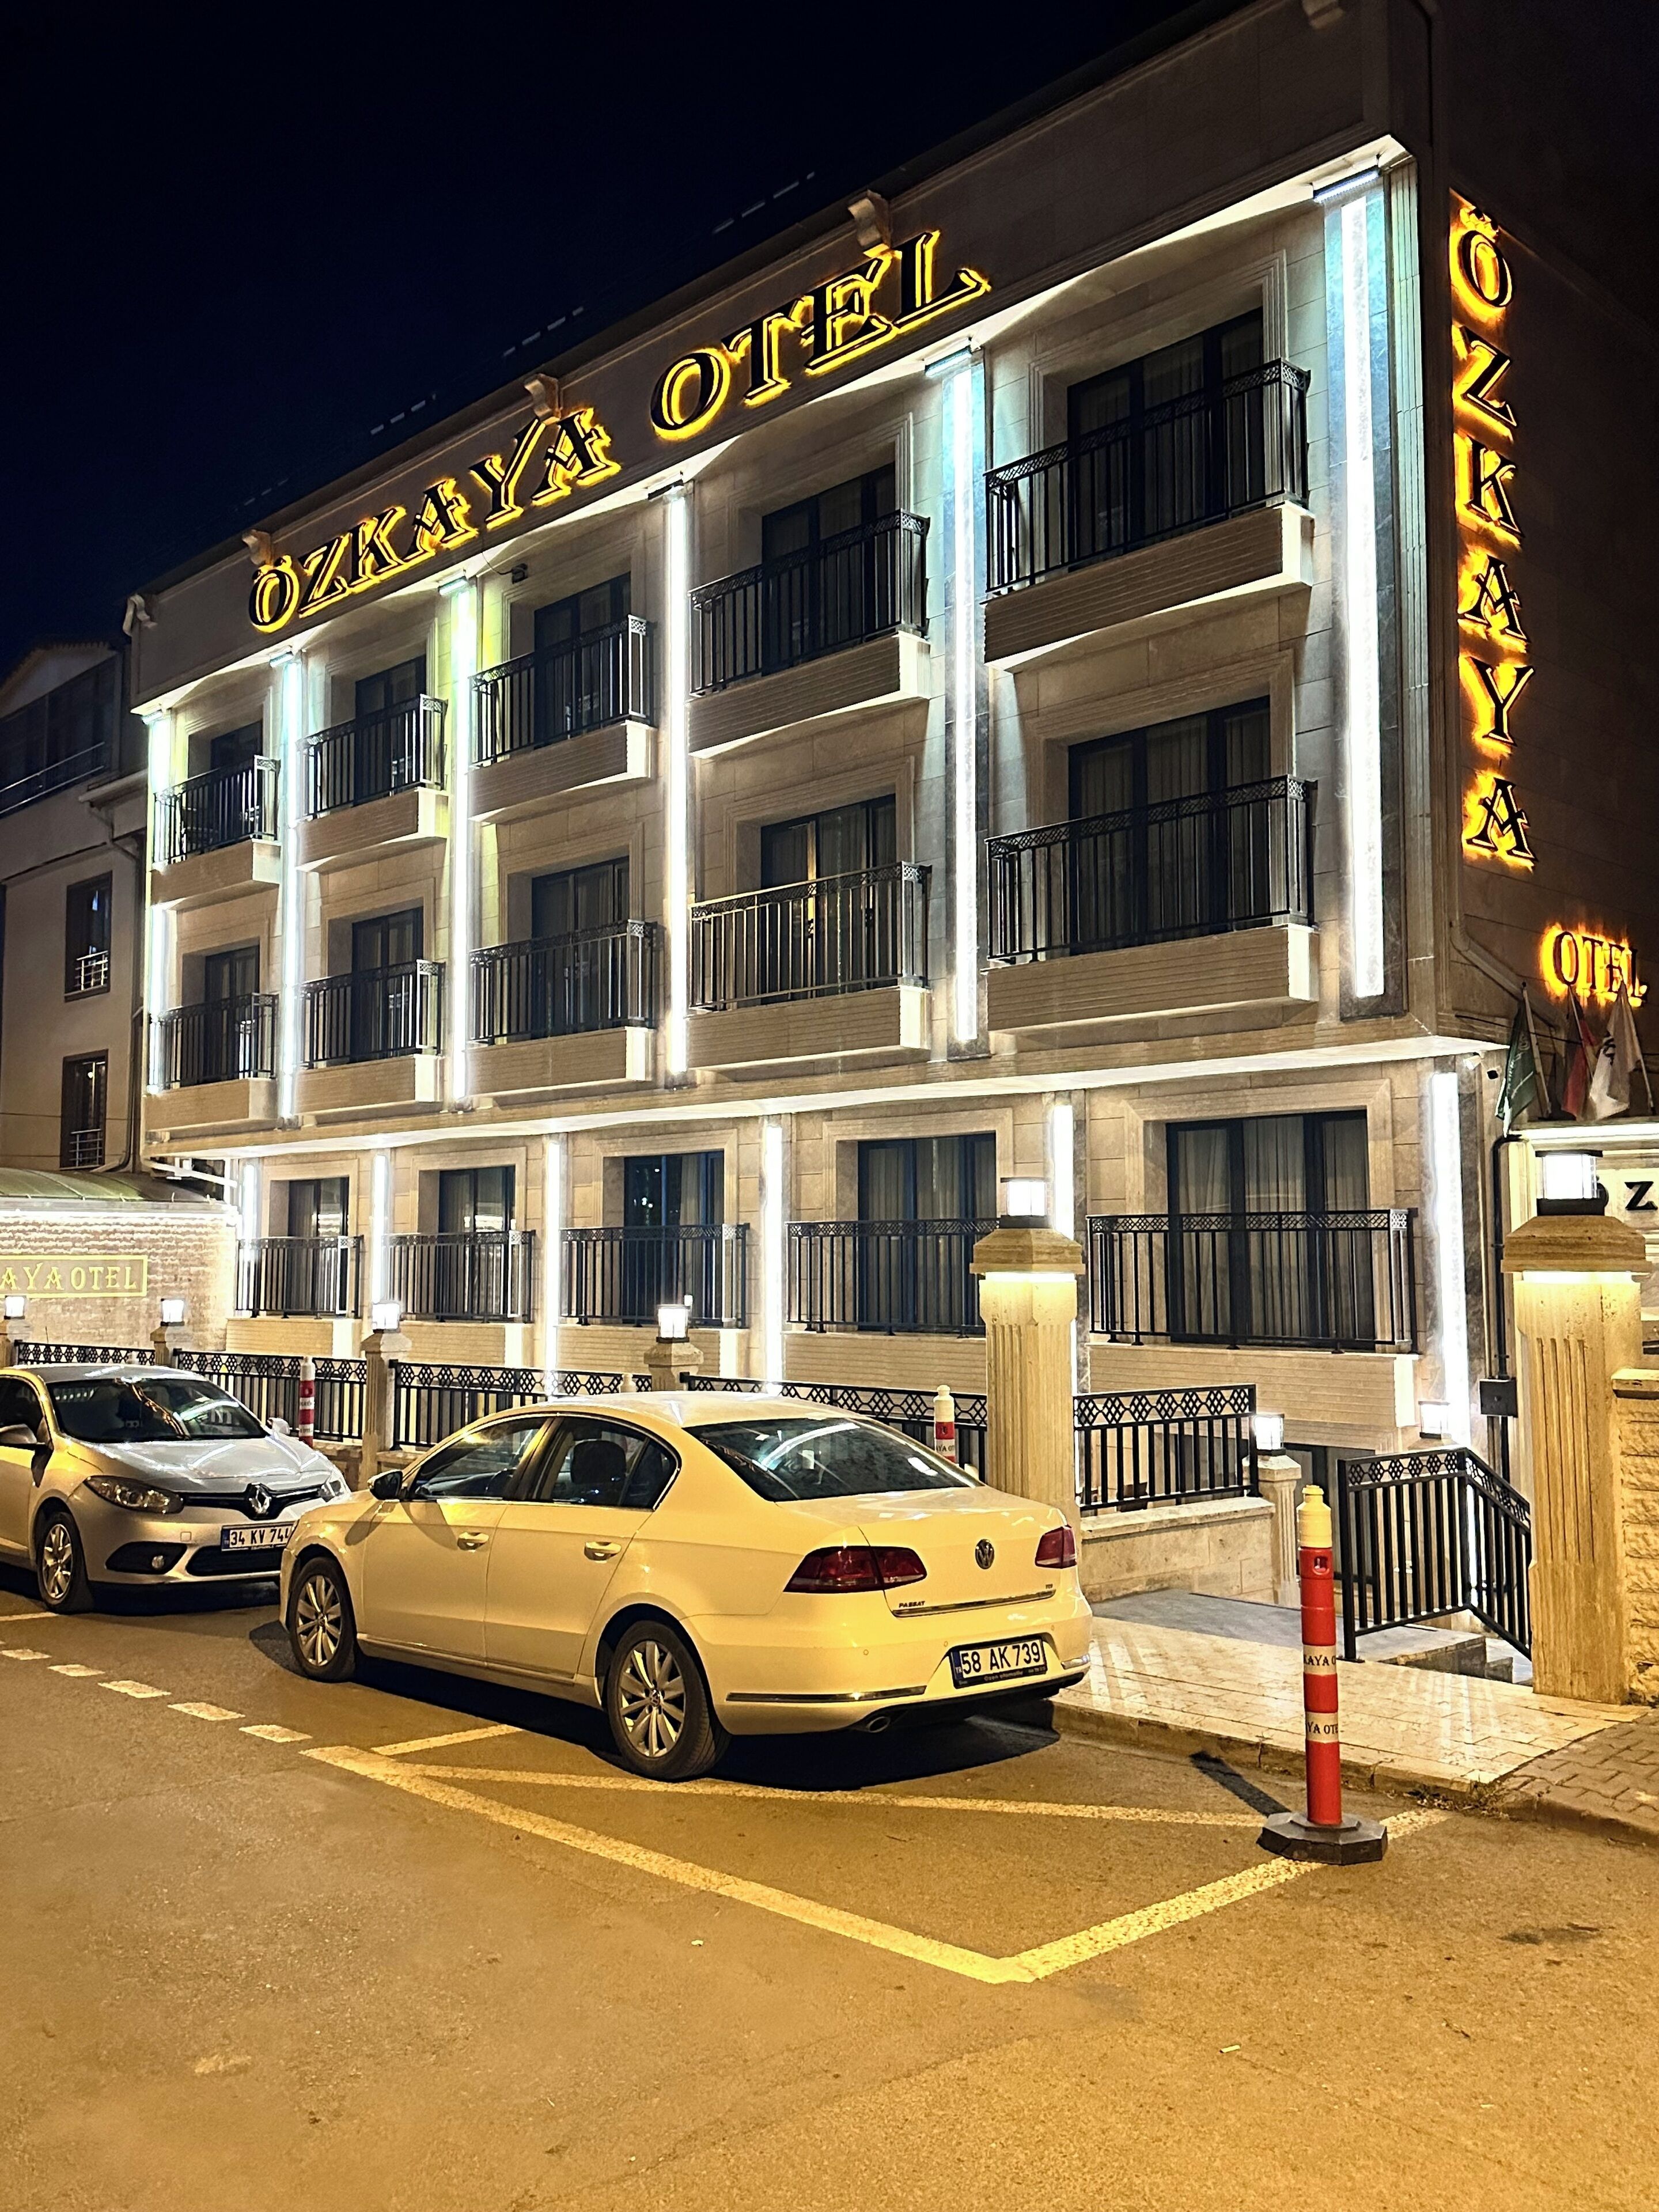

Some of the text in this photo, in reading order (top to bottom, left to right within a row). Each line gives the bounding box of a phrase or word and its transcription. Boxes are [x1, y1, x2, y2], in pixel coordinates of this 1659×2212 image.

[249, 230, 991, 632] ÖZKAYA OTEL
[1551, 929, 1647, 1007] OTEL
[71, 1266, 137, 1290] OTEL
[230, 1531, 245, 1545] 34
[251, 1529, 266, 1544] KV
[961, 1642, 1040, 1674] 58 AK 739
